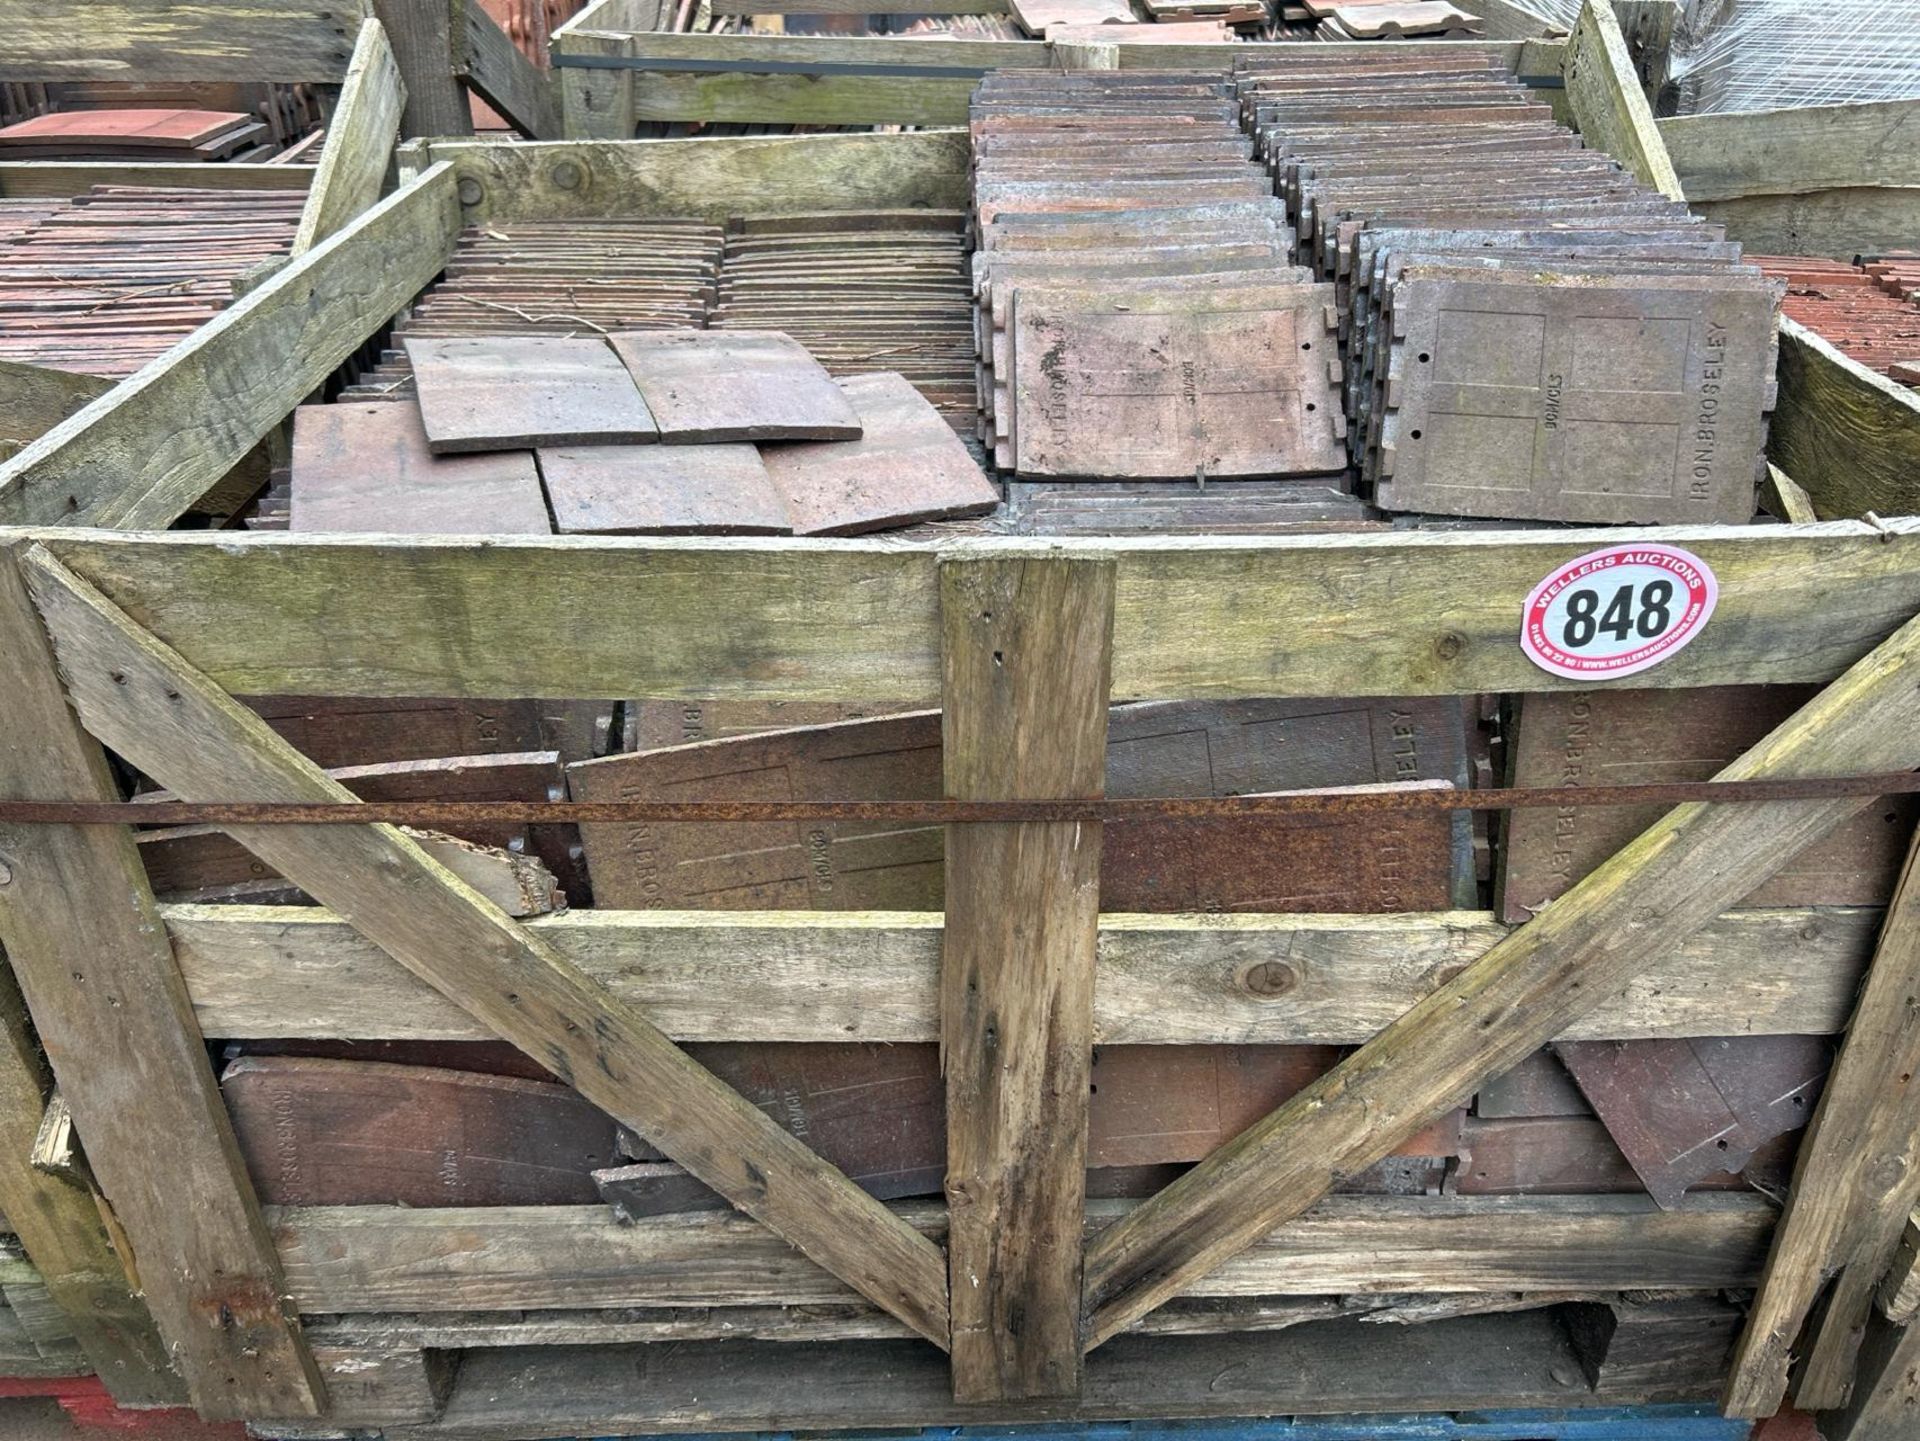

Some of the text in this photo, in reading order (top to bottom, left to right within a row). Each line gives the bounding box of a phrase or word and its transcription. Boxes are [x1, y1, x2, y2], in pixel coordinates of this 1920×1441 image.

[1536, 553, 1701, 609] WELLERS AUCTIONS
[1563, 579, 1673, 648] 848
